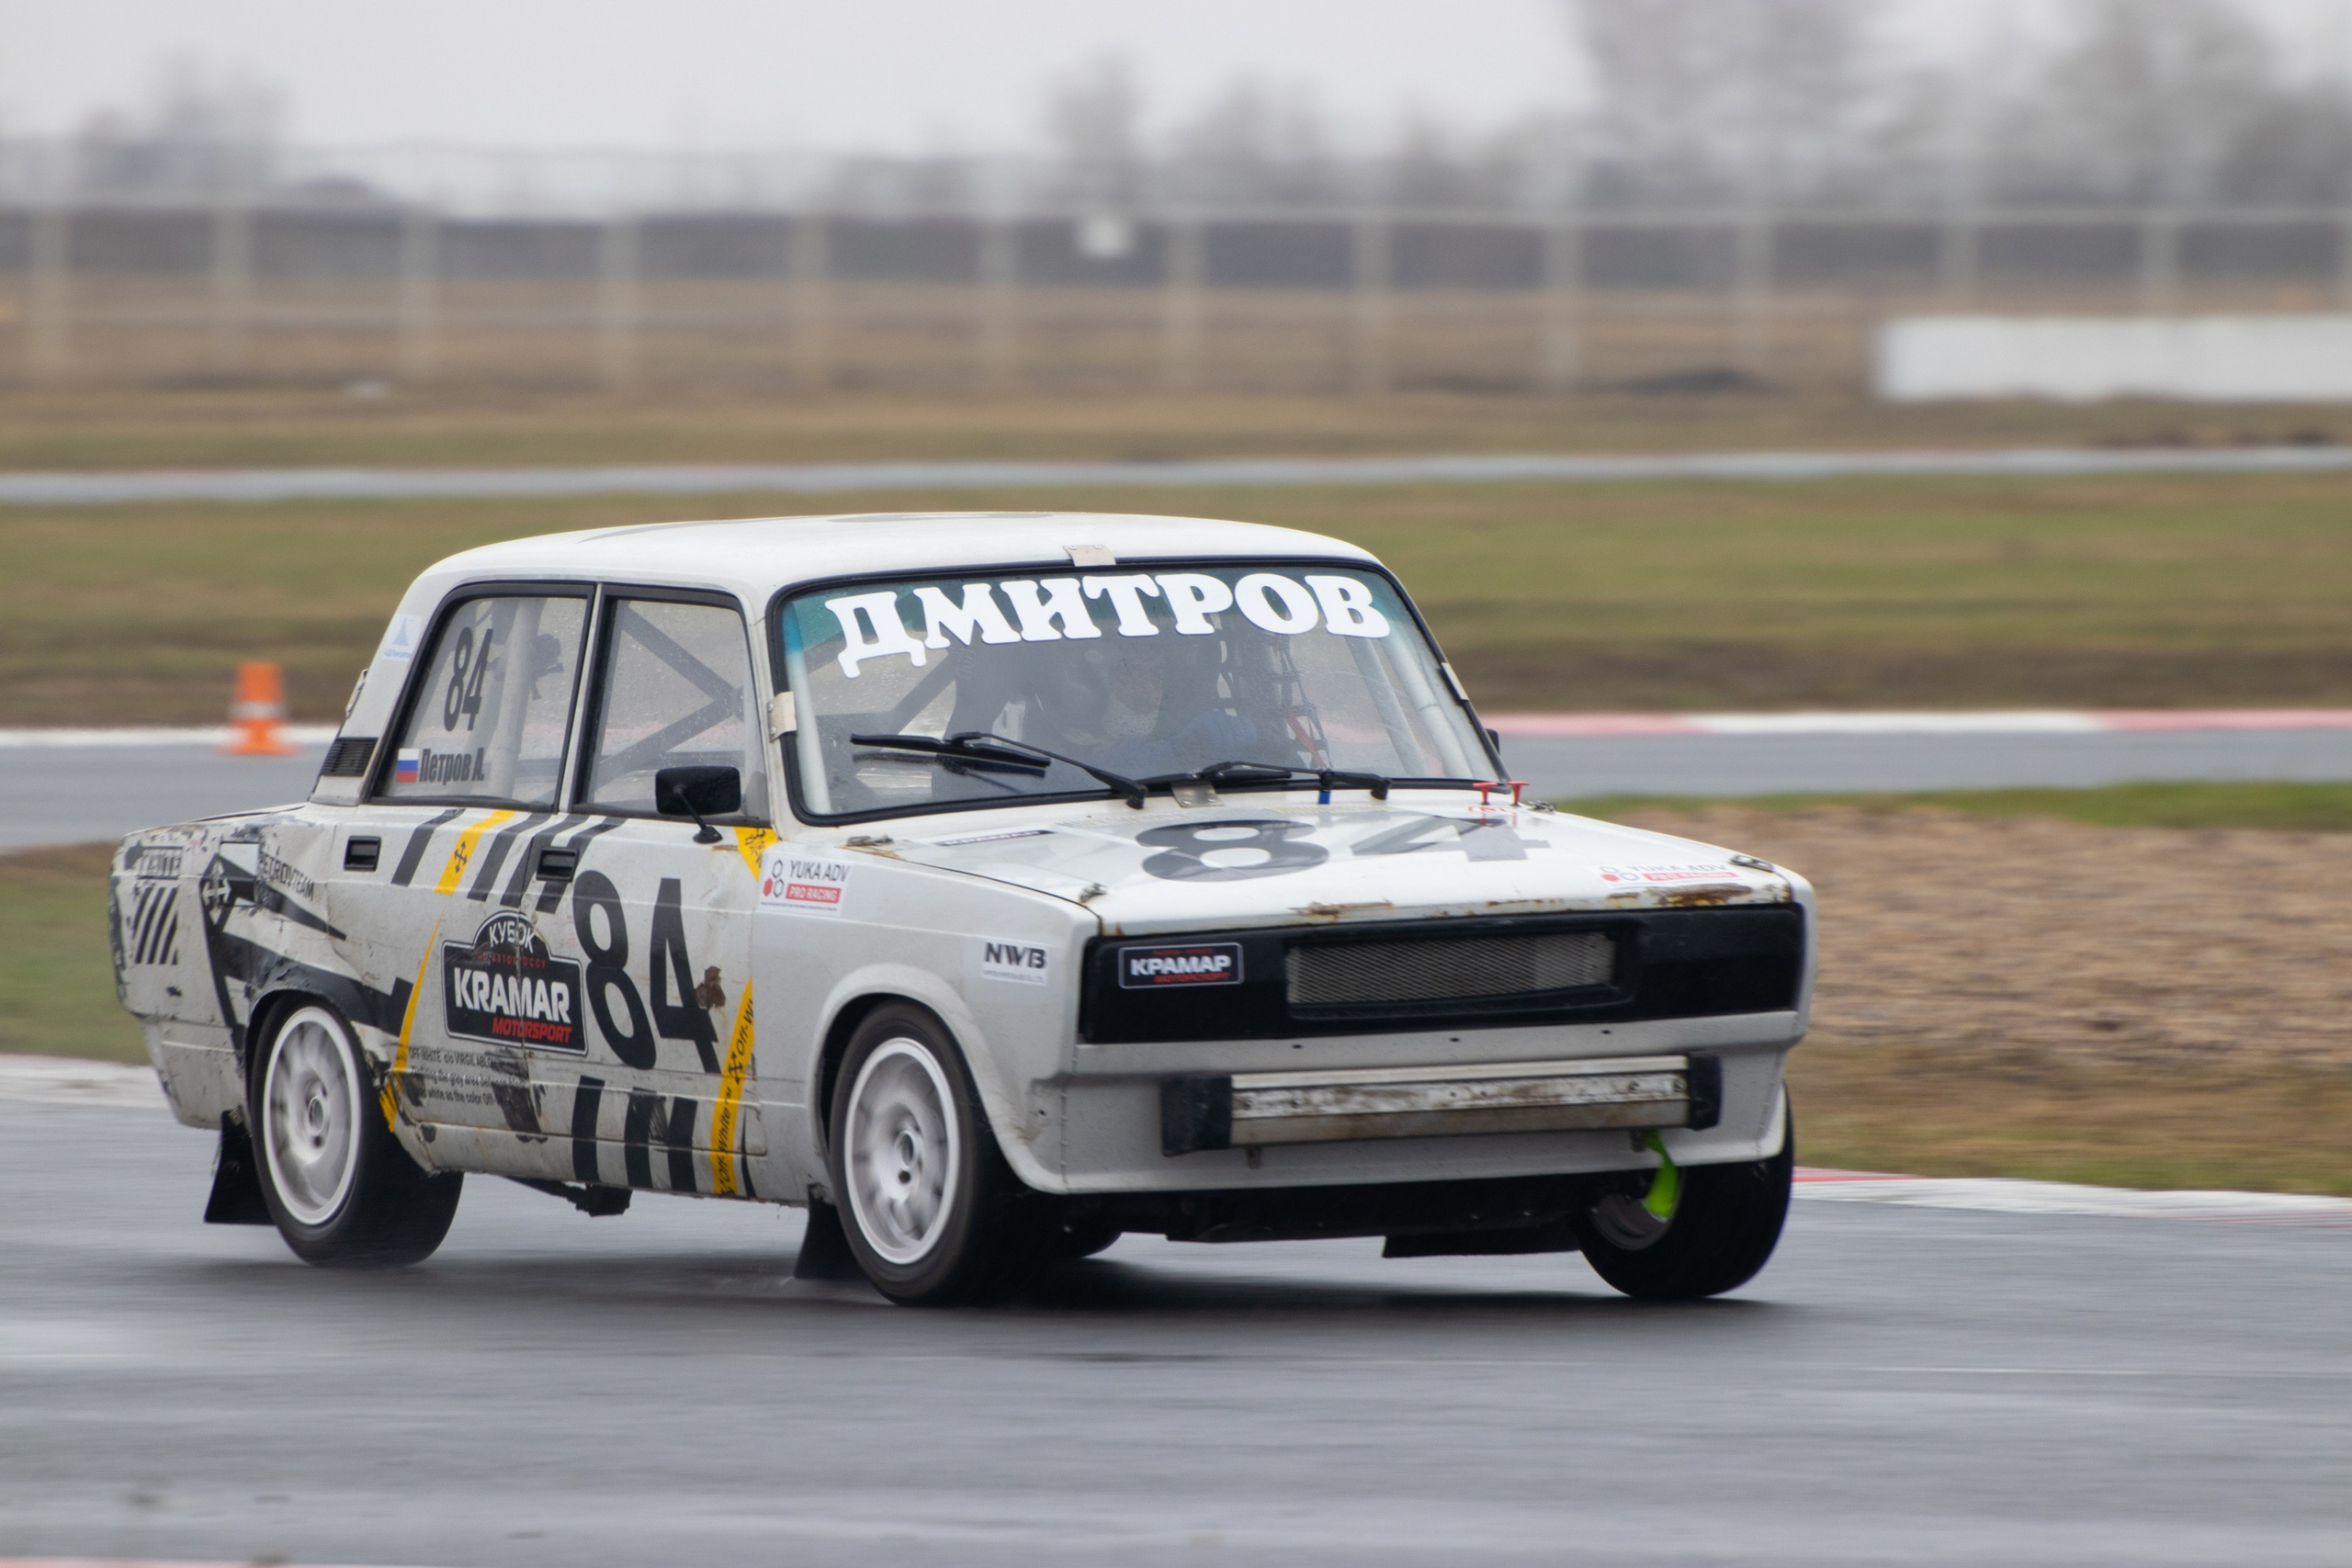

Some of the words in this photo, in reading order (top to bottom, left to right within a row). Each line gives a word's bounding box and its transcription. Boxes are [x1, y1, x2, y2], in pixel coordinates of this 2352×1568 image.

[825, 572, 1391, 679] ДМИТРОВ
[444, 626, 493, 732] 84
[419, 748, 471, 786] Петров
[1135, 817, 1551, 882] 84
[790, 860, 821, 881] YUKA
[824, 864, 851, 882] ADV
[788, 886, 806, 899] PRO
[808, 887, 838, 902] RACING
[489, 920, 536, 953] КУБОК
[984, 942, 1046, 969] NWB
[572, 870, 721, 1073] 84
[454, 967, 571, 1024] KRAMAR
[492, 1016, 572, 1043] MOTORSPORT
